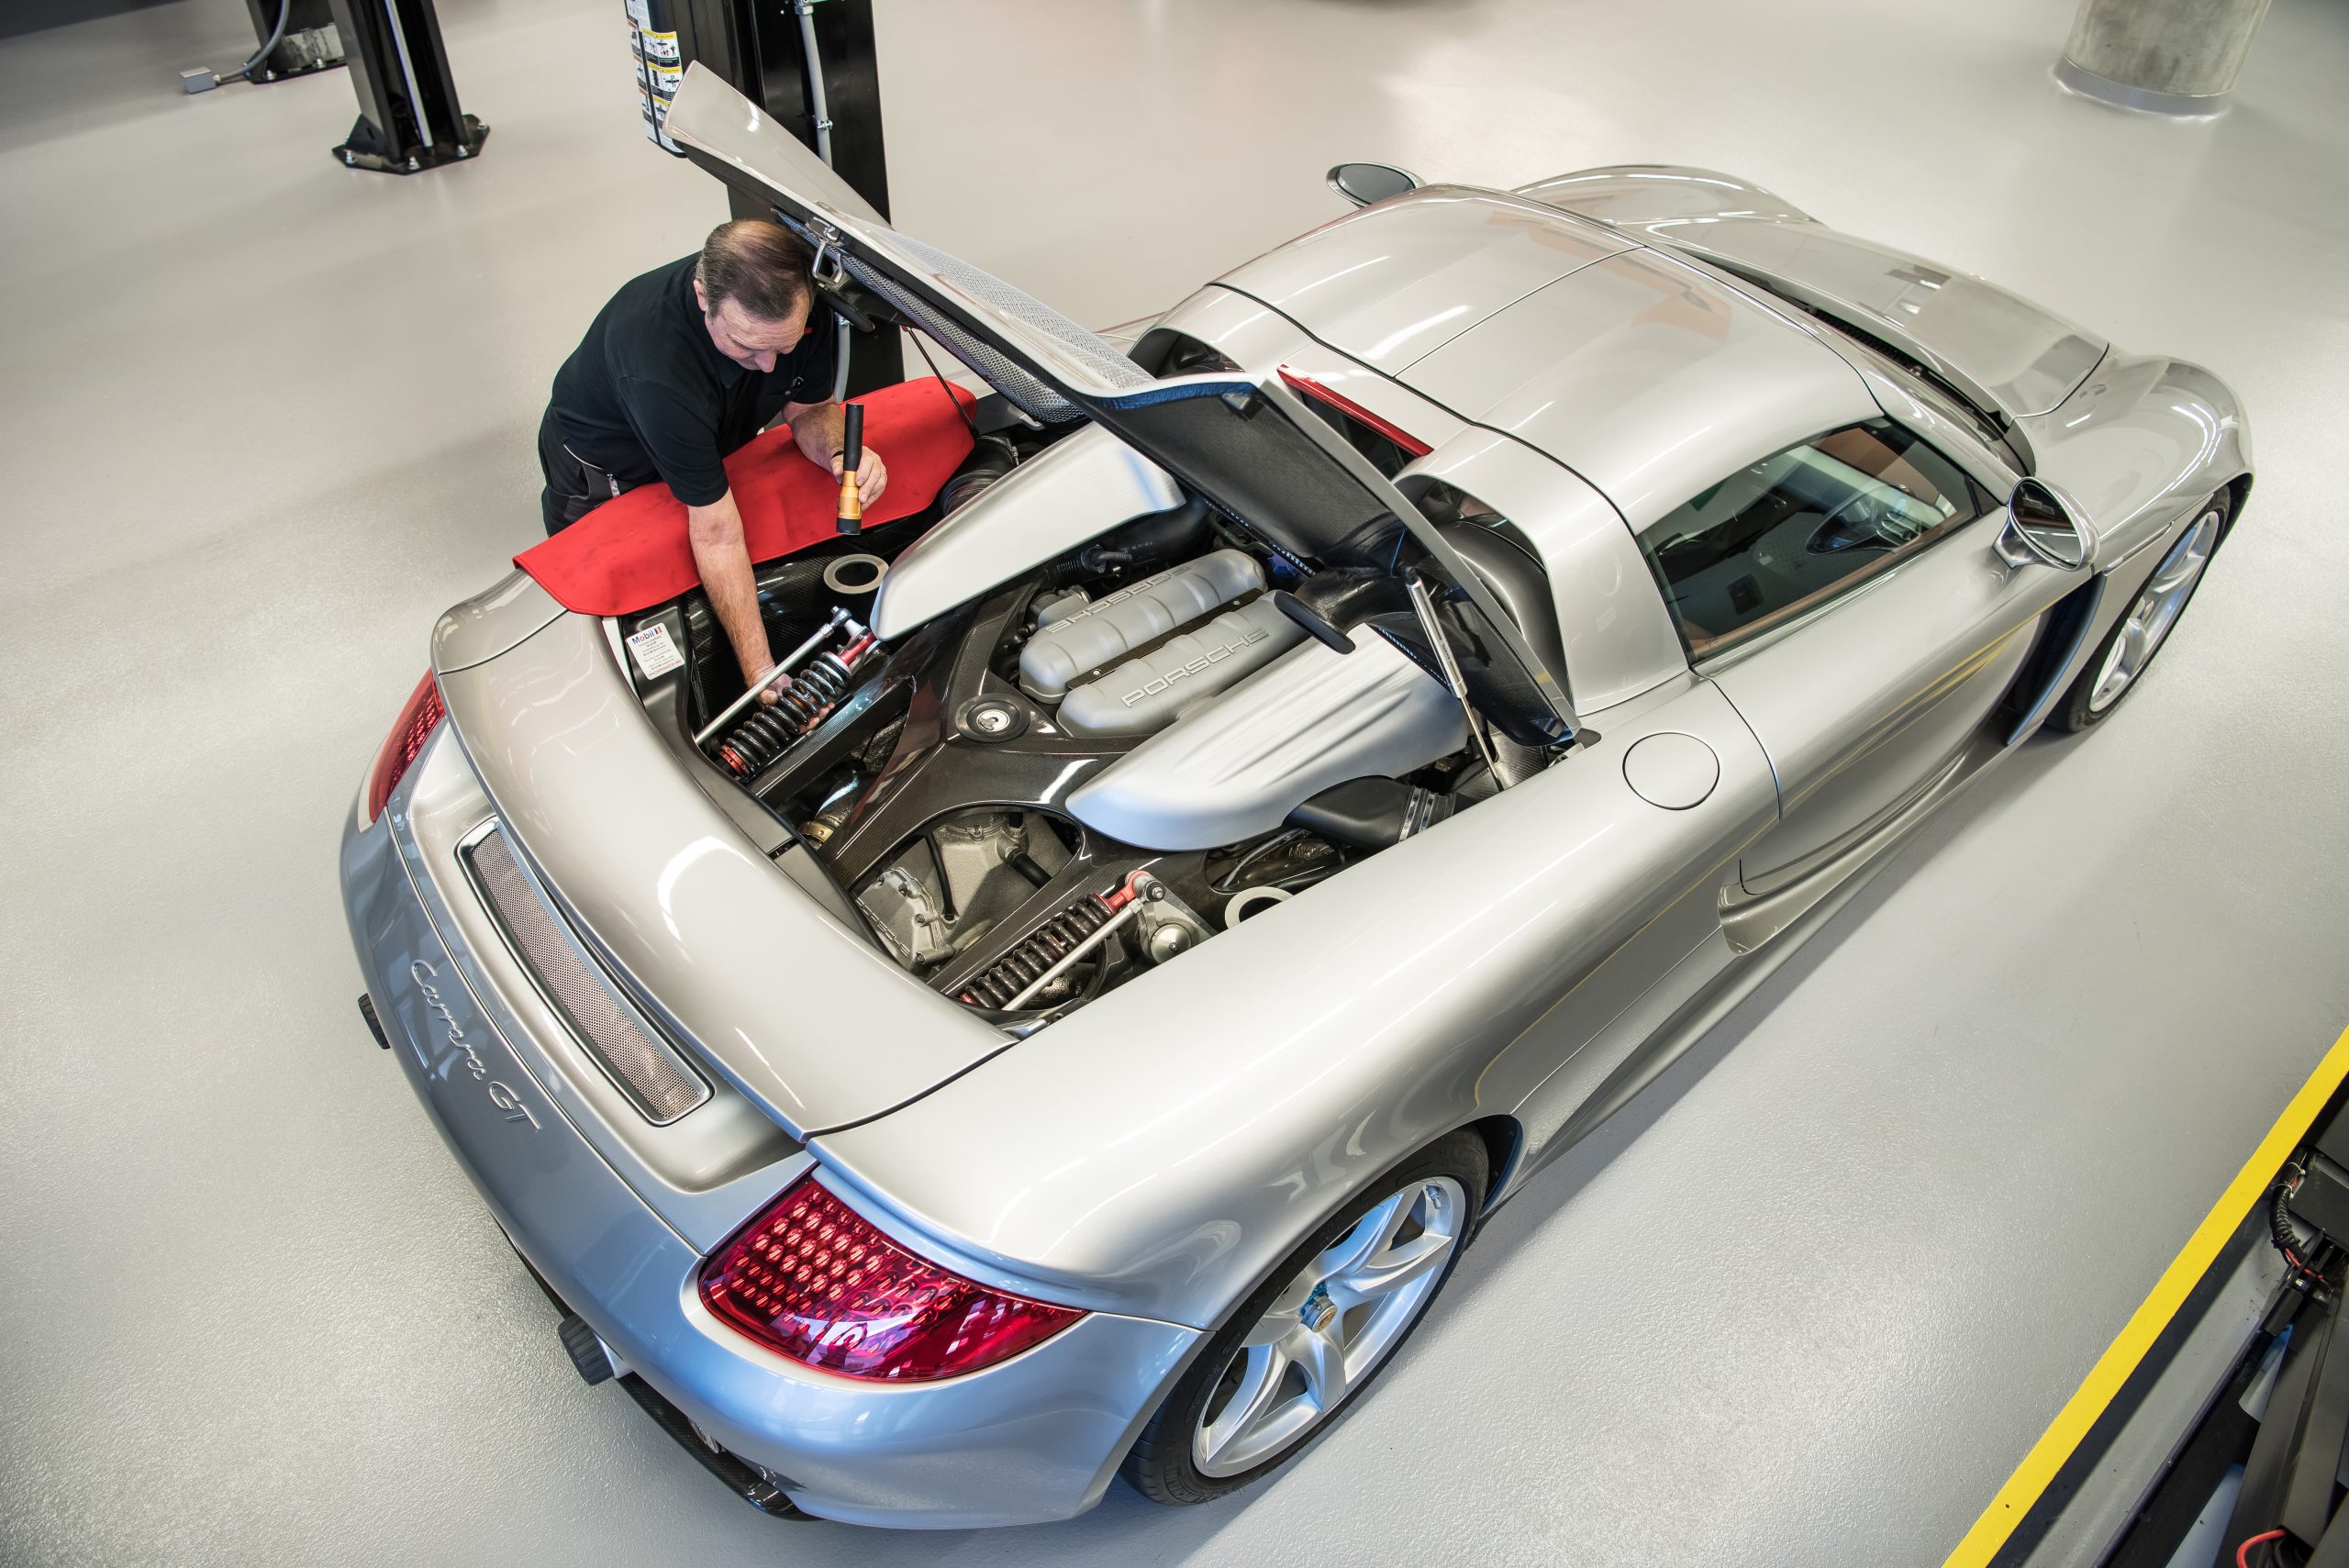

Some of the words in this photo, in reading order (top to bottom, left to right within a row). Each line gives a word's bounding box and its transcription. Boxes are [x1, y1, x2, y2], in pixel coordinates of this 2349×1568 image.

[1045, 566, 1191, 633] PORSCHE
[632, 629, 654, 644] Mobil
[1120, 627, 1270, 707] PORSCHE
[411, 959, 485, 1081] Carrera
[488, 1081, 541, 1130] GT
